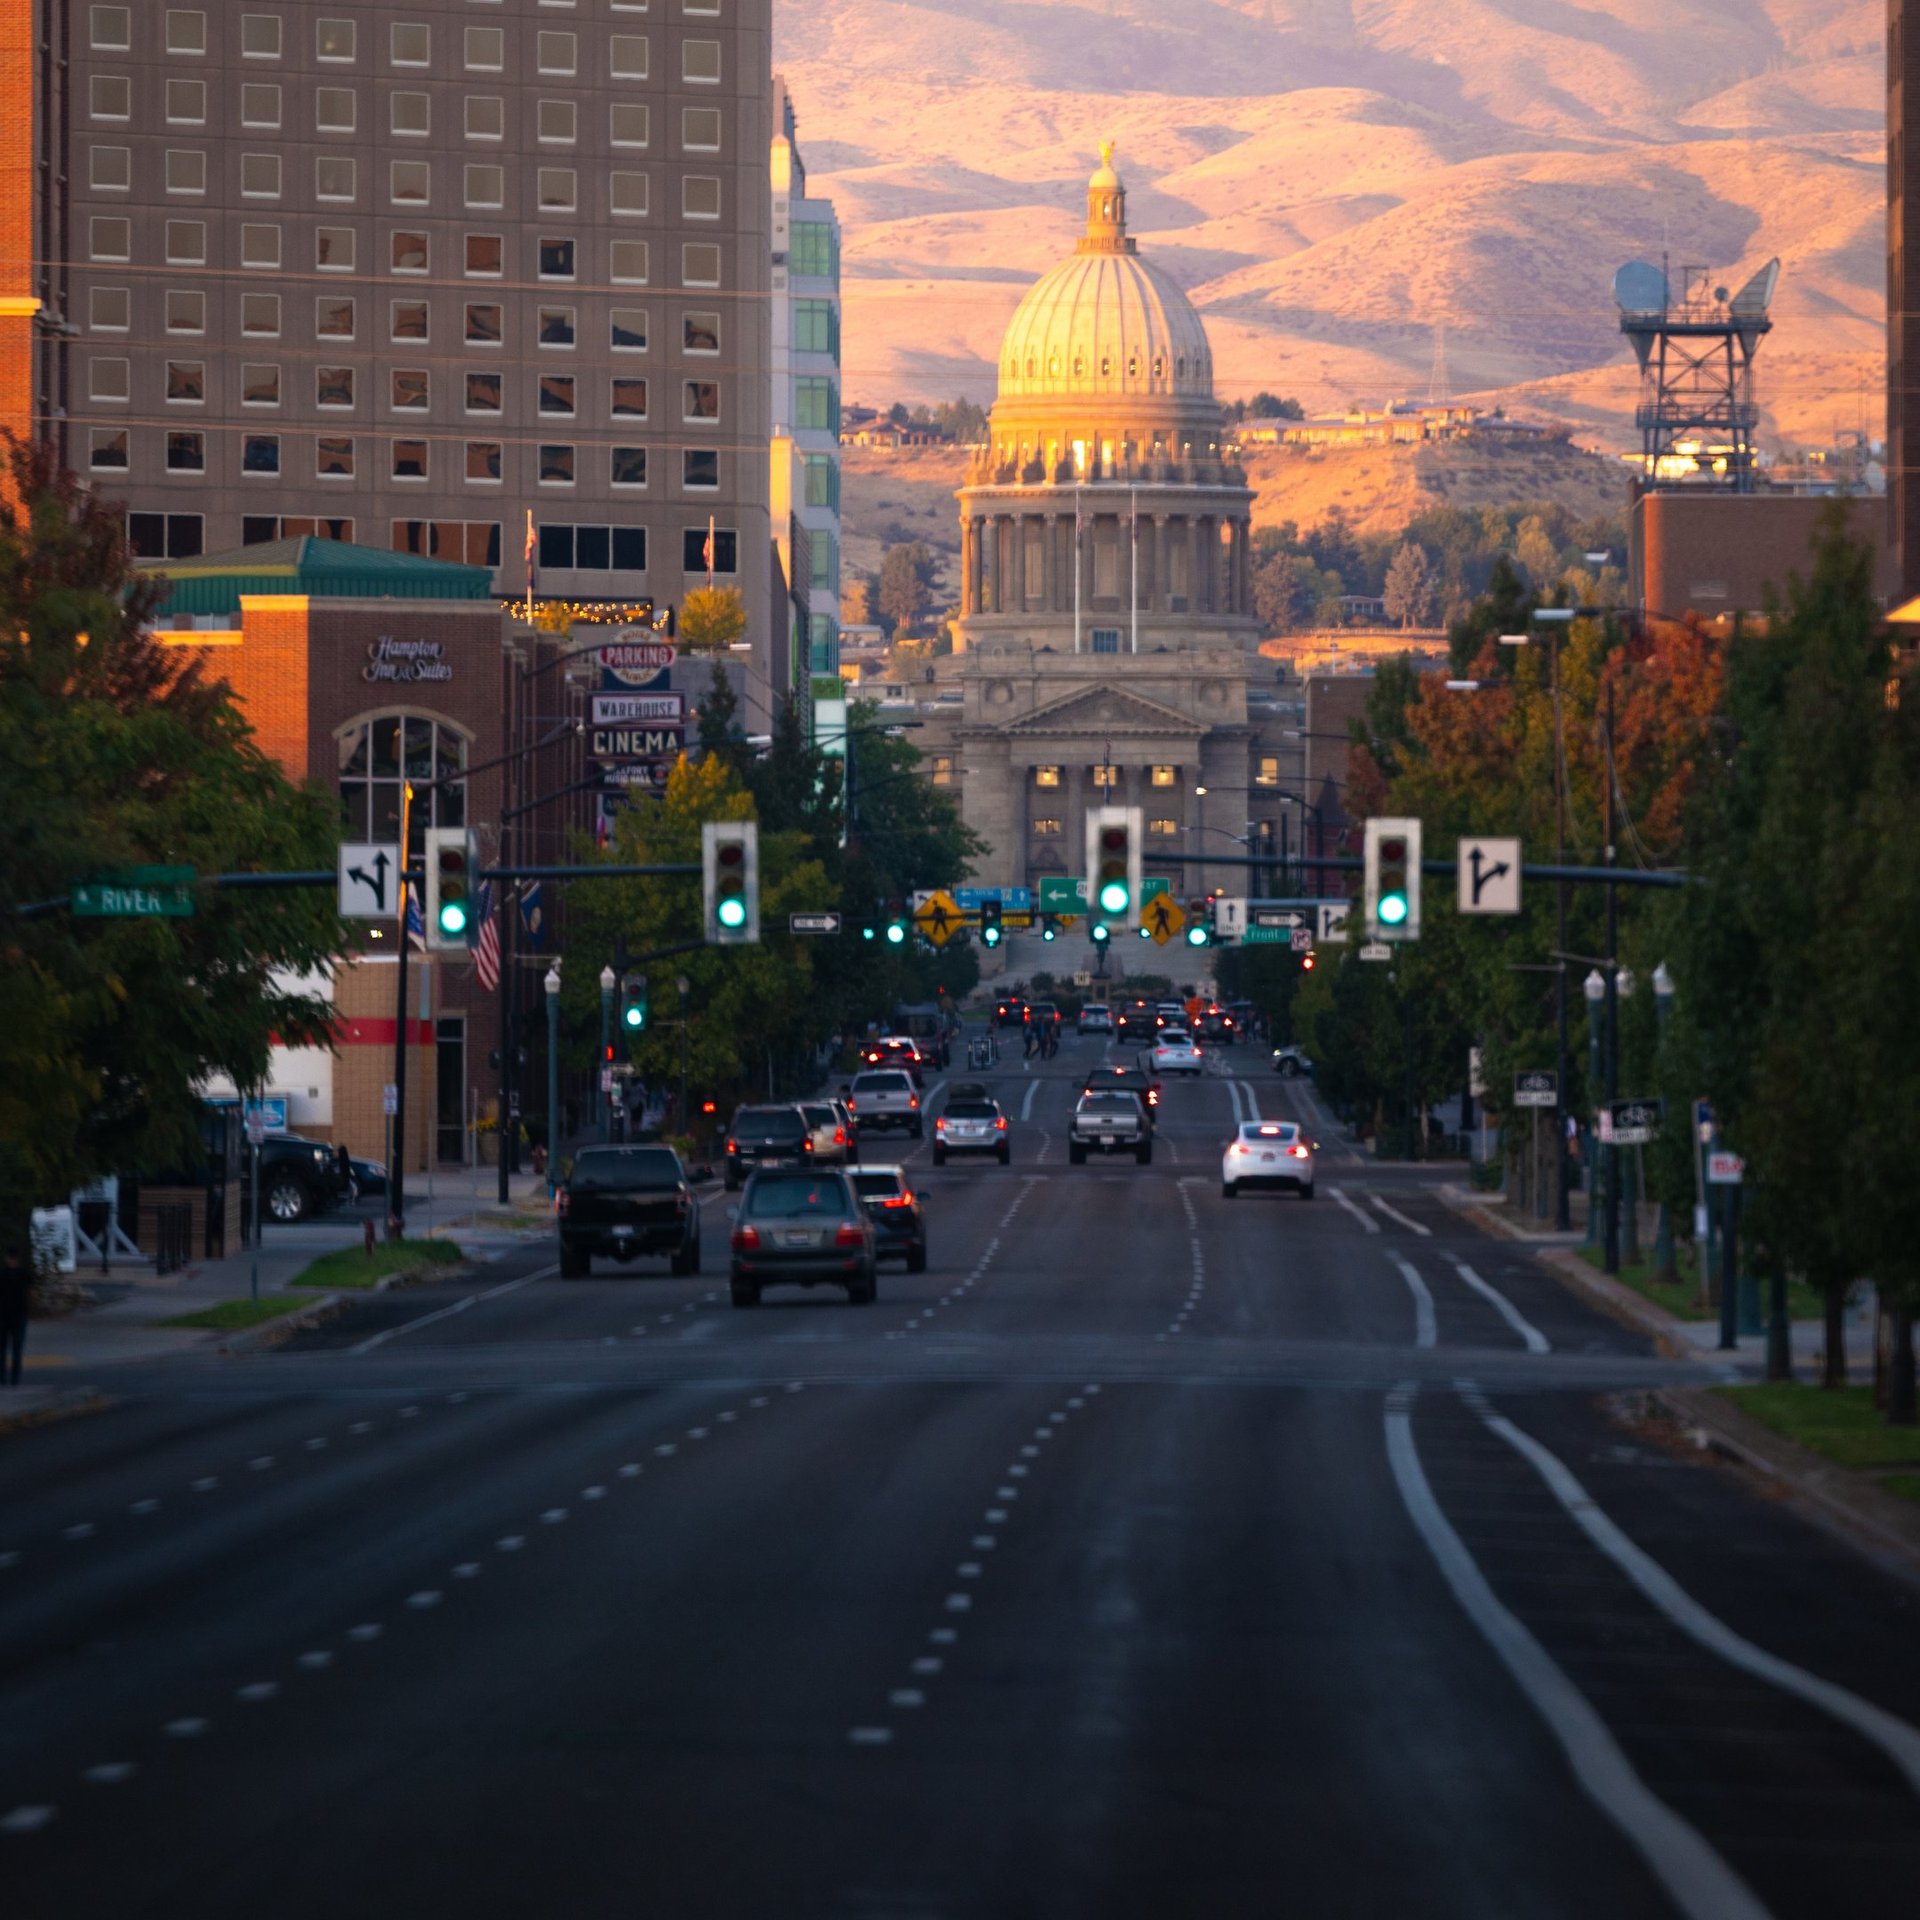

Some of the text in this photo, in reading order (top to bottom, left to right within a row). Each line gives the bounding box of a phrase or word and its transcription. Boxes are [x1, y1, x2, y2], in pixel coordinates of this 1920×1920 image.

[368, 635, 445, 660] Hampton
[606, 645, 669, 664] PARKING
[362, 660, 400, 682] Inn
[410, 659, 453, 681] Suites
[599, 701, 674, 717] WAREHOUSE
[593, 731, 678, 754] CINEMA
[1138, 881, 1157, 890] EST
[102, 888, 161, 912] RIVER
